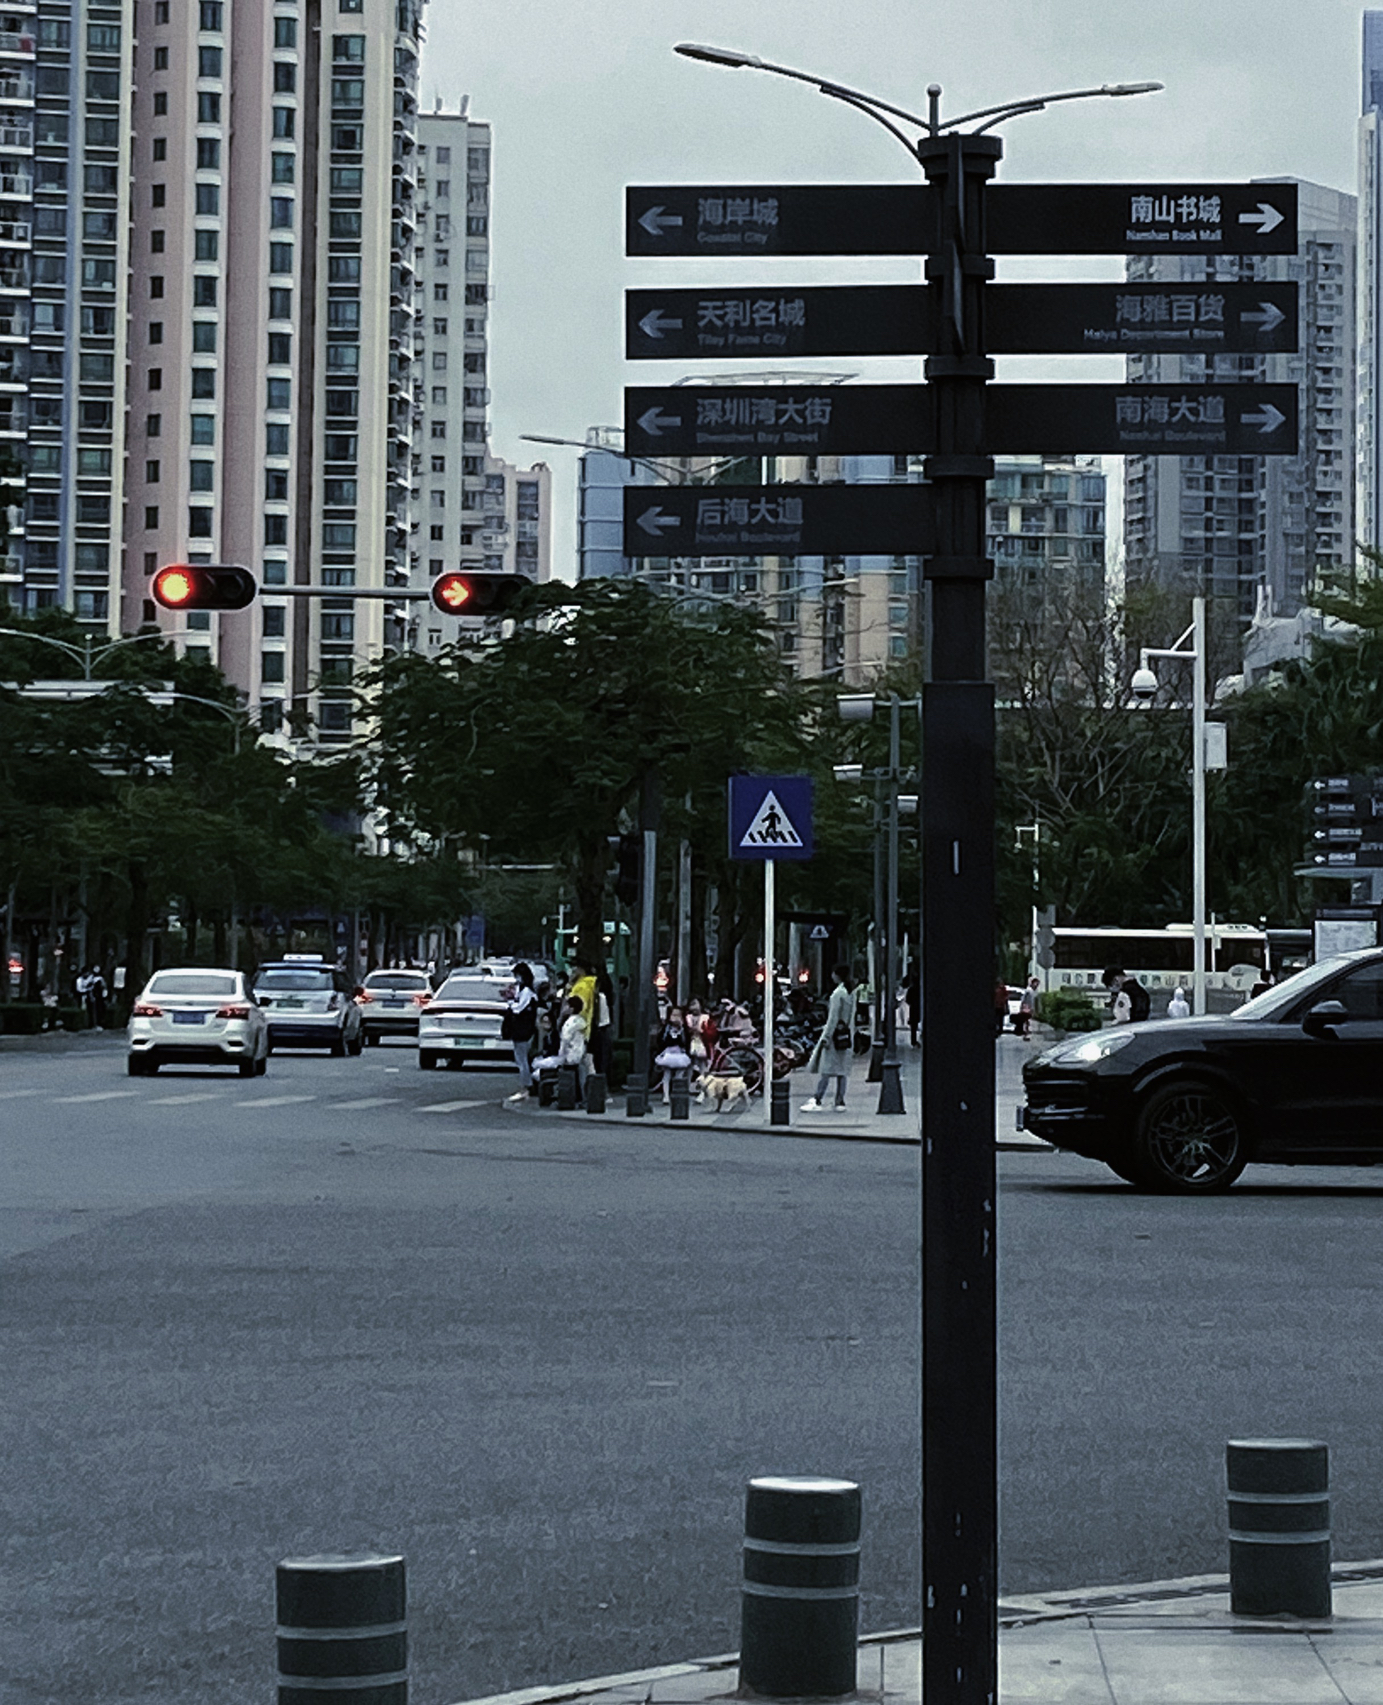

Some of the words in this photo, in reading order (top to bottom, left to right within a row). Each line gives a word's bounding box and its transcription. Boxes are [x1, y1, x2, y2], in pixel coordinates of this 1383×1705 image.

[698, 197, 779, 225] 海岸城
[1131, 195, 1221, 223] 南山书城
[744, 231, 768, 245] City
[697, 298, 806, 327] 天利名城
[1115, 294, 1225, 322] 海雅百货
[696, 397, 832, 427] 深圳湾大街
[1115, 395, 1225, 424] 南海大道
[696, 496, 804, 525] 后海大道
